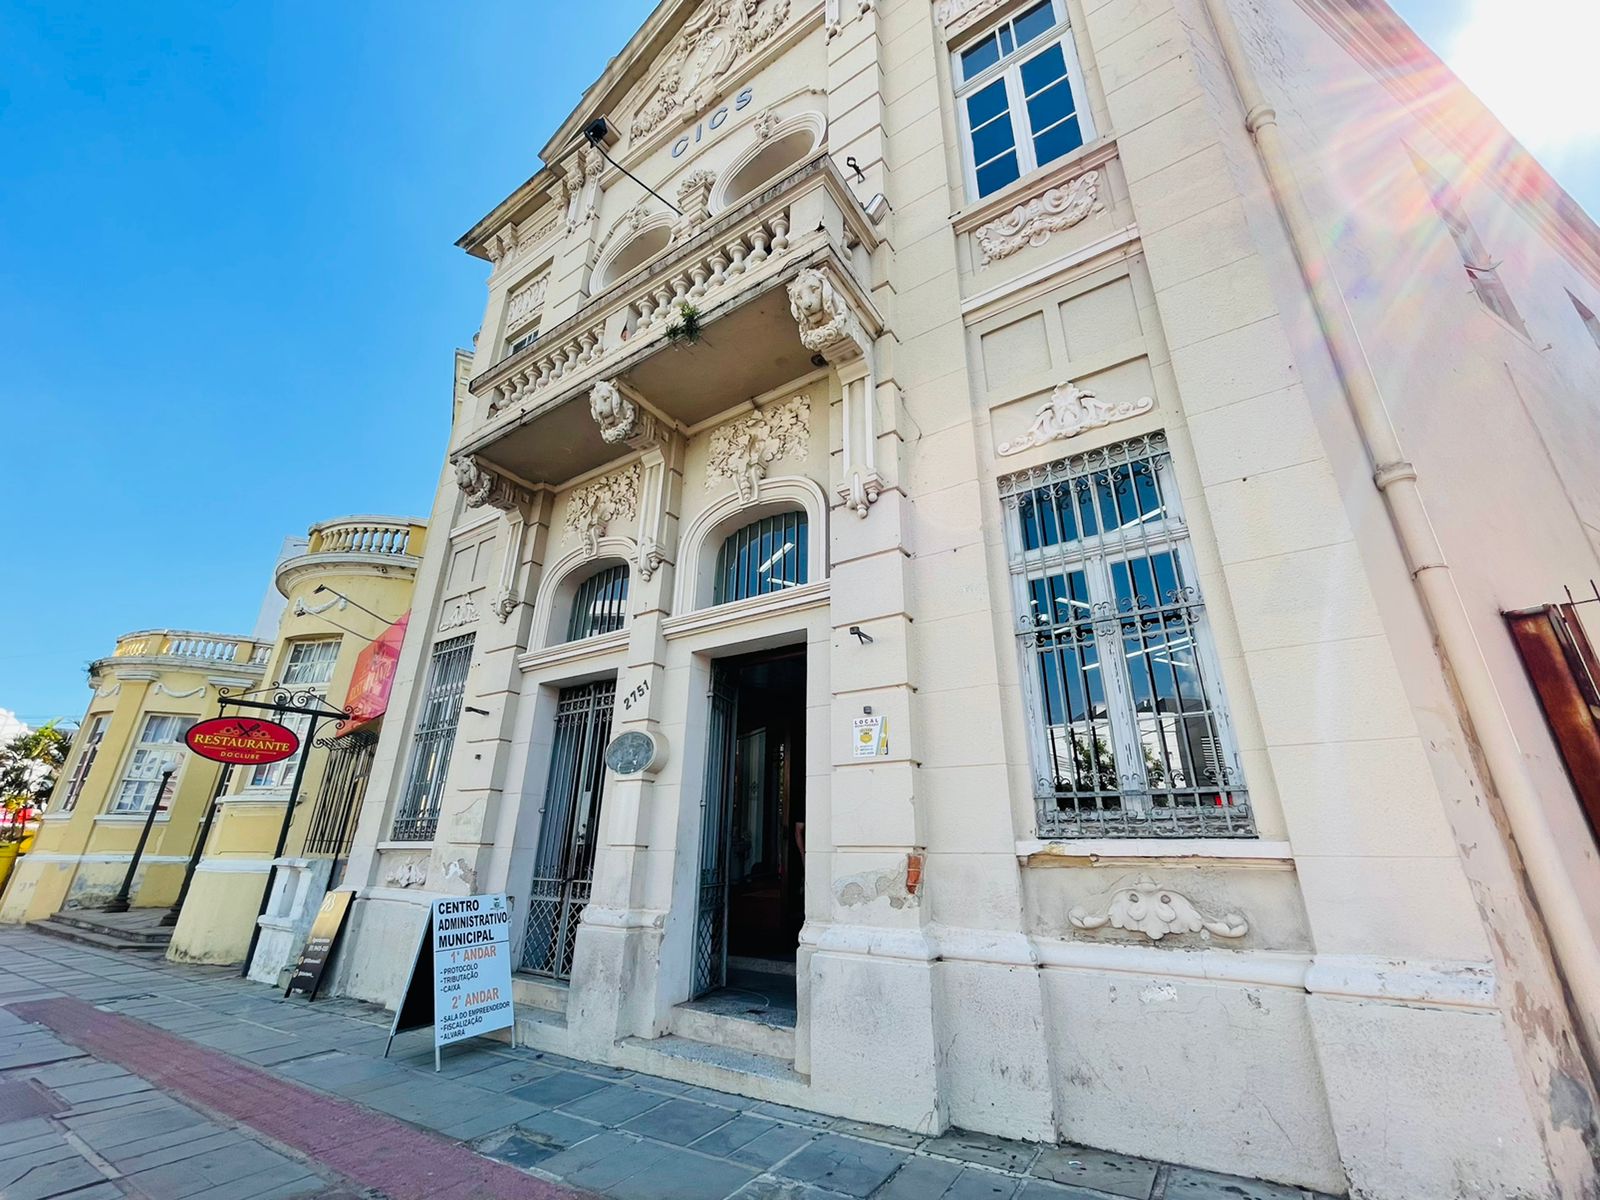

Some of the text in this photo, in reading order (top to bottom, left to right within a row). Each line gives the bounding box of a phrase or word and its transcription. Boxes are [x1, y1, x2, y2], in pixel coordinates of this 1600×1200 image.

[672, 87, 752, 158] CICS
[623, 679, 649, 710] 2751
[194, 733, 290, 752] RESTAURANTE
[234, 752, 260, 760] CLUBE
[438, 899, 479, 914] CENTRO
[438, 912, 507, 931] ADMINISTRATIVO
[439, 929, 494, 948] MUNICIPAL
[463, 945, 496, 962] ANDAR
[465, 987, 499, 1007] ANDAR
[459, 1011, 468, 1019] DO
[468, 1001, 510, 1017] EMPREENDEDOR
